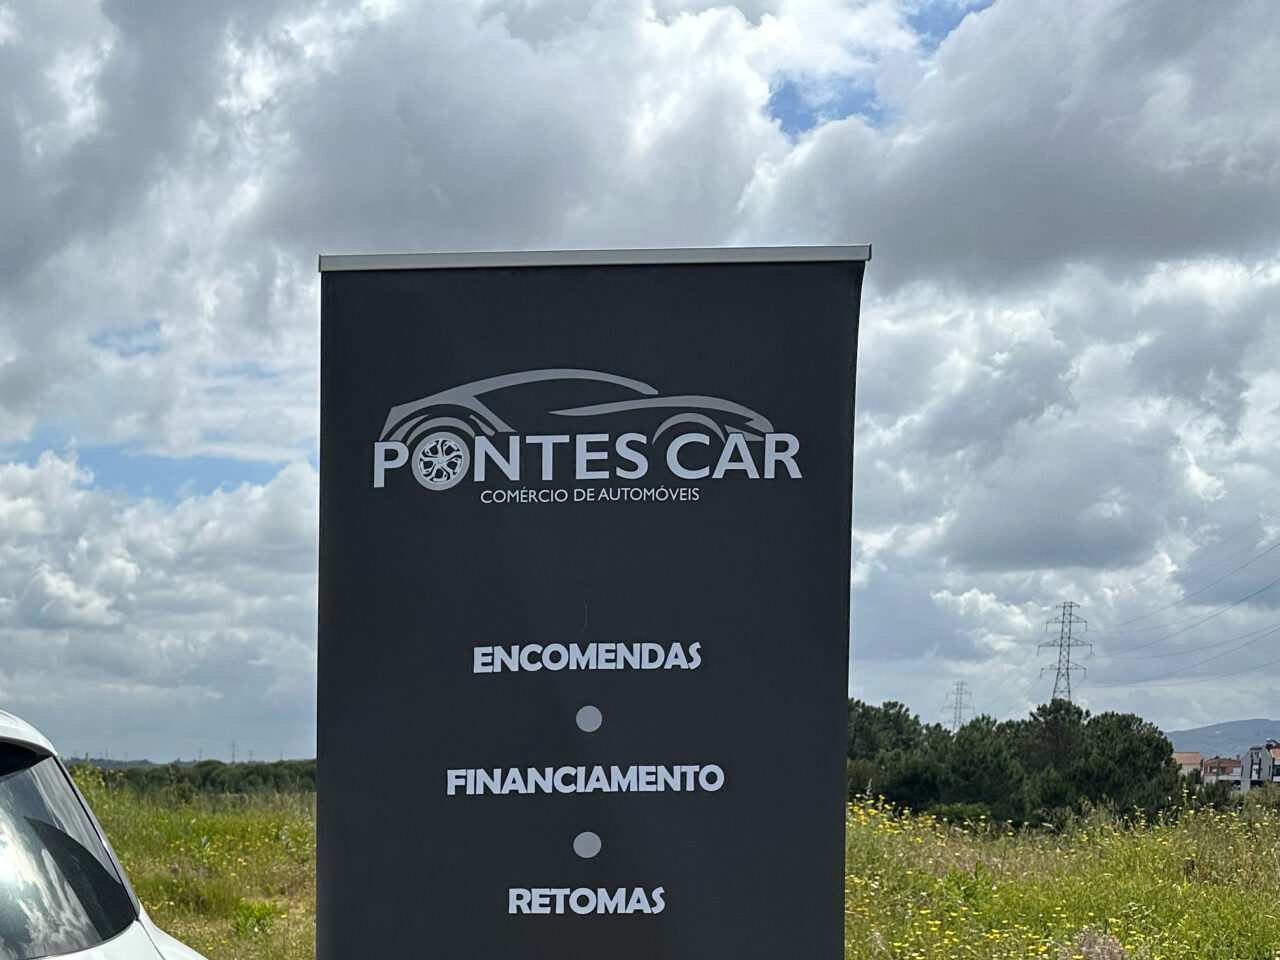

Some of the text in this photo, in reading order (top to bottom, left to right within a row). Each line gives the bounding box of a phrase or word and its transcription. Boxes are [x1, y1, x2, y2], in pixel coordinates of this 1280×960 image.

[373, 432, 803, 491] PONTES CAR
[480, 484, 700, 504] COMÉRCIO DE AUTOMÓVEIS
[473, 642, 702, 673] ENCOMENDAS
[446, 764, 725, 795] FINANCIAMENTO
[508, 886, 666, 915] RETOMAS
